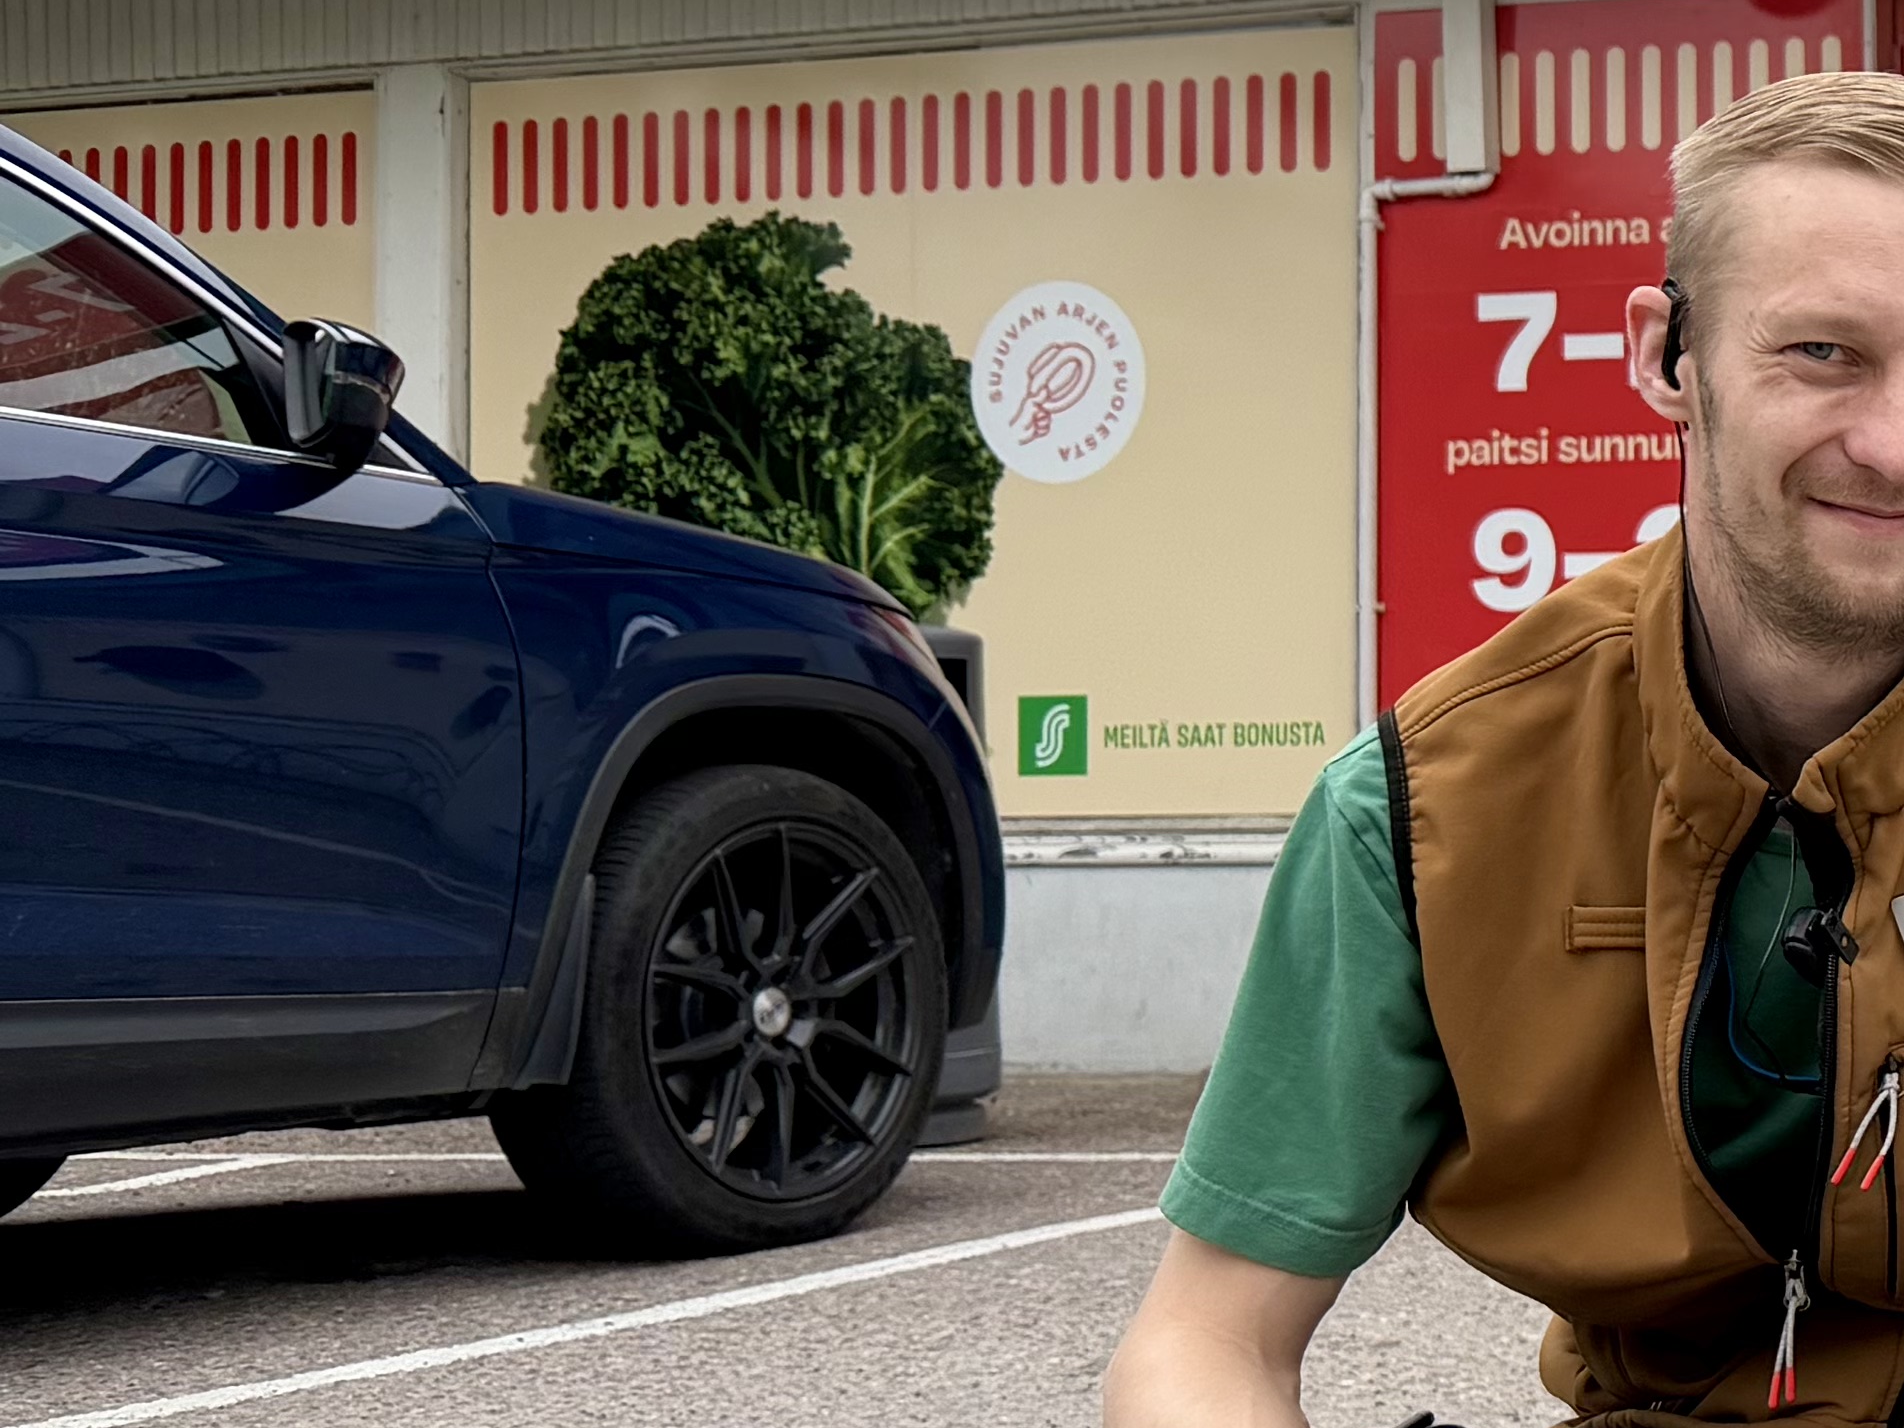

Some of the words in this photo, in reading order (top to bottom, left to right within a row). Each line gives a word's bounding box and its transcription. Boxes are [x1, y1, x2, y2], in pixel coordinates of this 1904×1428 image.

[1499, 211, 1651, 250] Avoinna
[1056, 300, 1120, 350] ARJEN
[1476, 290, 1643, 393] 7-
[989, 304, 1047, 404] SUJUVAN
[1057, 359, 1128, 462] PUOLESTA
[1446, 428, 1549, 476] paitsi
[1103, 719, 1170, 749] MEILTÄ
[1177, 723, 1227, 748] SAAT
[1233, 722, 1326, 748] BONUSTA
